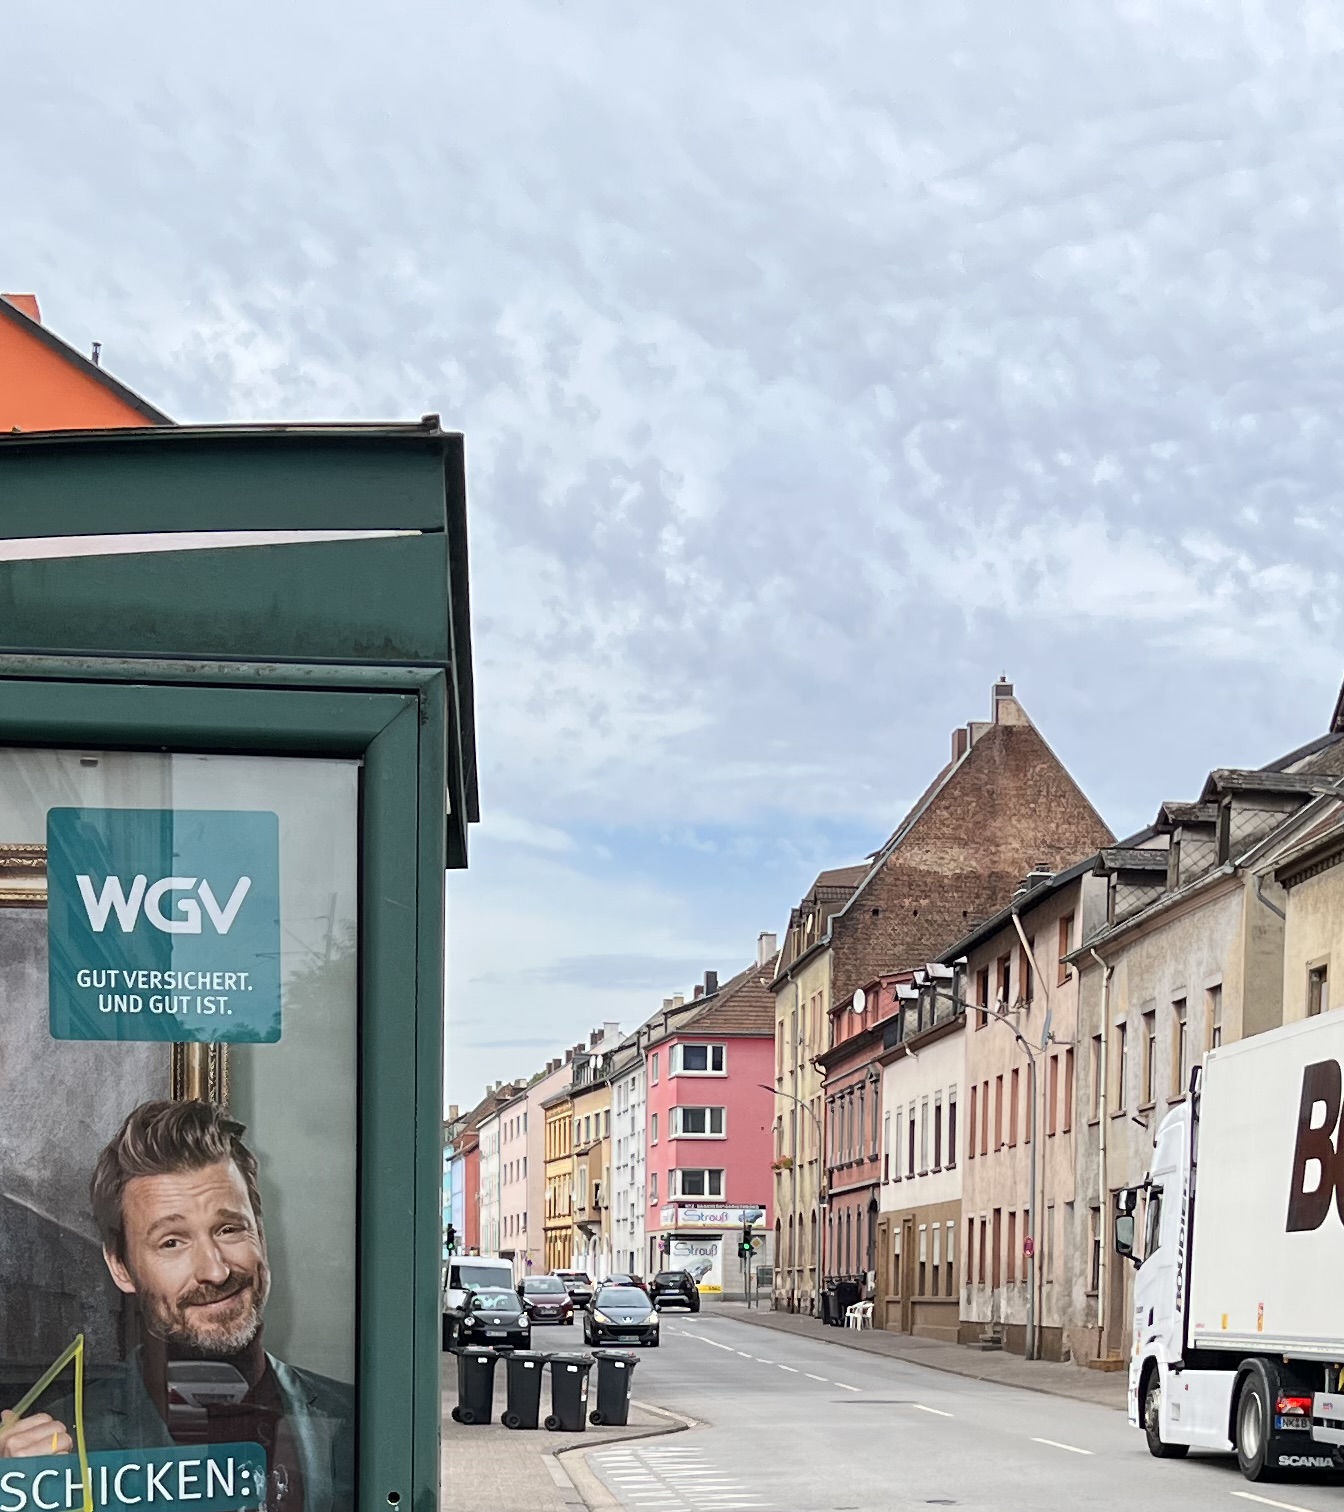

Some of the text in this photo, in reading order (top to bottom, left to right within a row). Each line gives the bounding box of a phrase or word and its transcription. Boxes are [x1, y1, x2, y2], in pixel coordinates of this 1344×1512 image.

[75, 873, 252, 935] WGV
[76, 969, 254, 991] GUT VERSICHERT.
[98, 994, 233, 1015] UND GUT IST.
[1278, 1455, 1335, 1468] SCANIA
